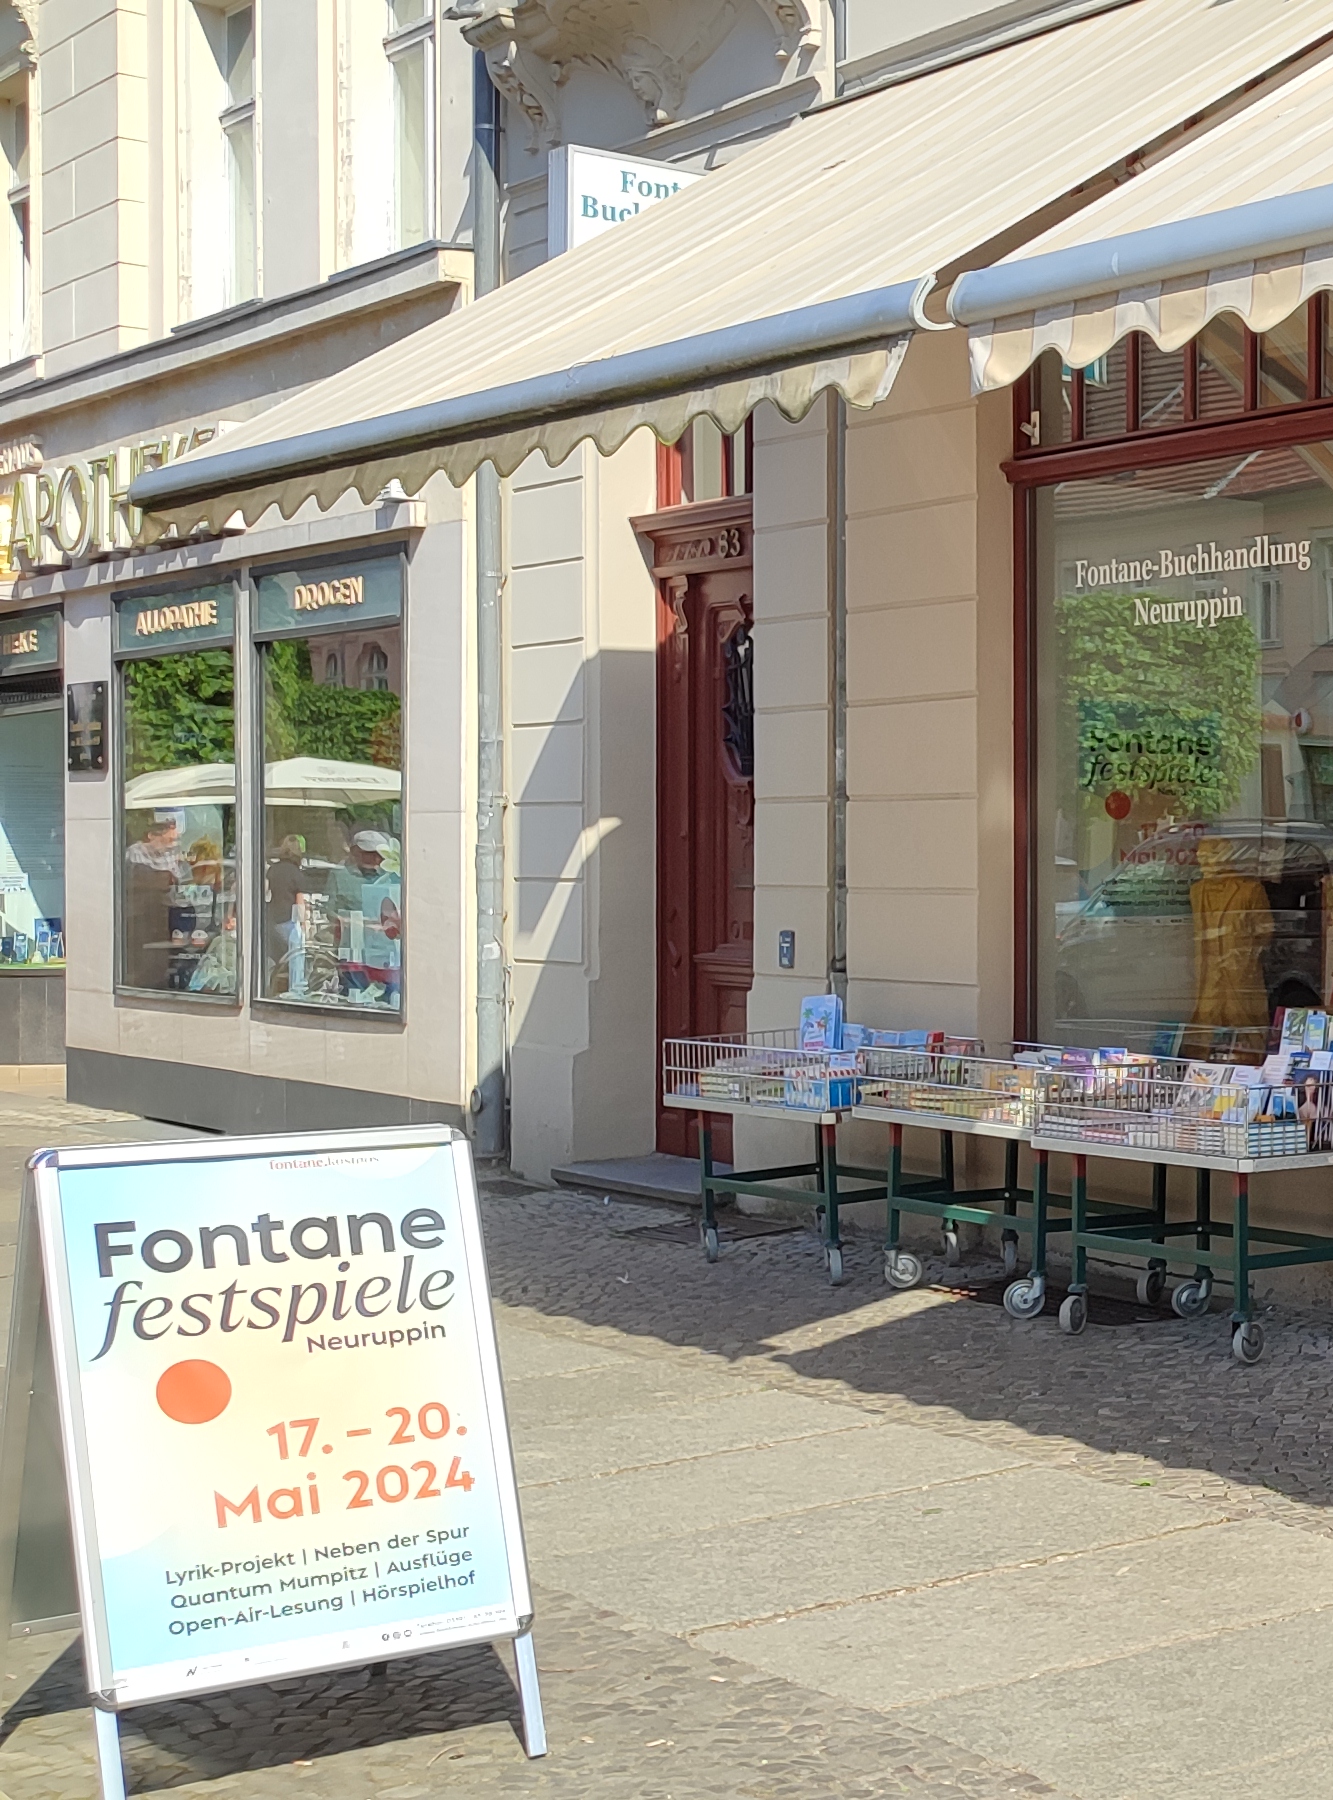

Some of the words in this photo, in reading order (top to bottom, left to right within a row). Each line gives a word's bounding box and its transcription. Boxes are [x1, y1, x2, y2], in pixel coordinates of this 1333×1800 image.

[1075, 535, 1312, 588] Fontane-Buchhandlung
[134, 600, 219, 637] ALLOPATHIE
[294, 576, 365, 611] DROGEN
[1133, 587, 1243, 628] Neuruppin
[1090, 729, 1212, 756] Fontane
[1085, 754, 1212, 789] festspiele
[94, 1207, 446, 1278] Fontane
[88, 1254, 456, 1362] festspiele
[306, 1320, 447, 1354] Neuruppin
[266, 1417, 334, 1461] 17.
[385, 1402, 468, 1446] 20.
[214, 1472, 321, 1529] Mai
[342, 1456, 476, 1511] 2024
[165, 1547, 297, 1586] Lyrik-Projekt
[314, 1538, 381, 1562] Neben
[387, 1531, 420, 1551] der
[426, 1523, 471, 1548] Spur
[170, 1579, 273, 1610] Quantum
[280, 1562, 369, 1595] Mumpitz
[386, 1546, 474, 1578] Ausflüge
[168, 1592, 344, 1637] Open-Air-Lesung
[362, 1569, 477, 1605] Hörspielhof
